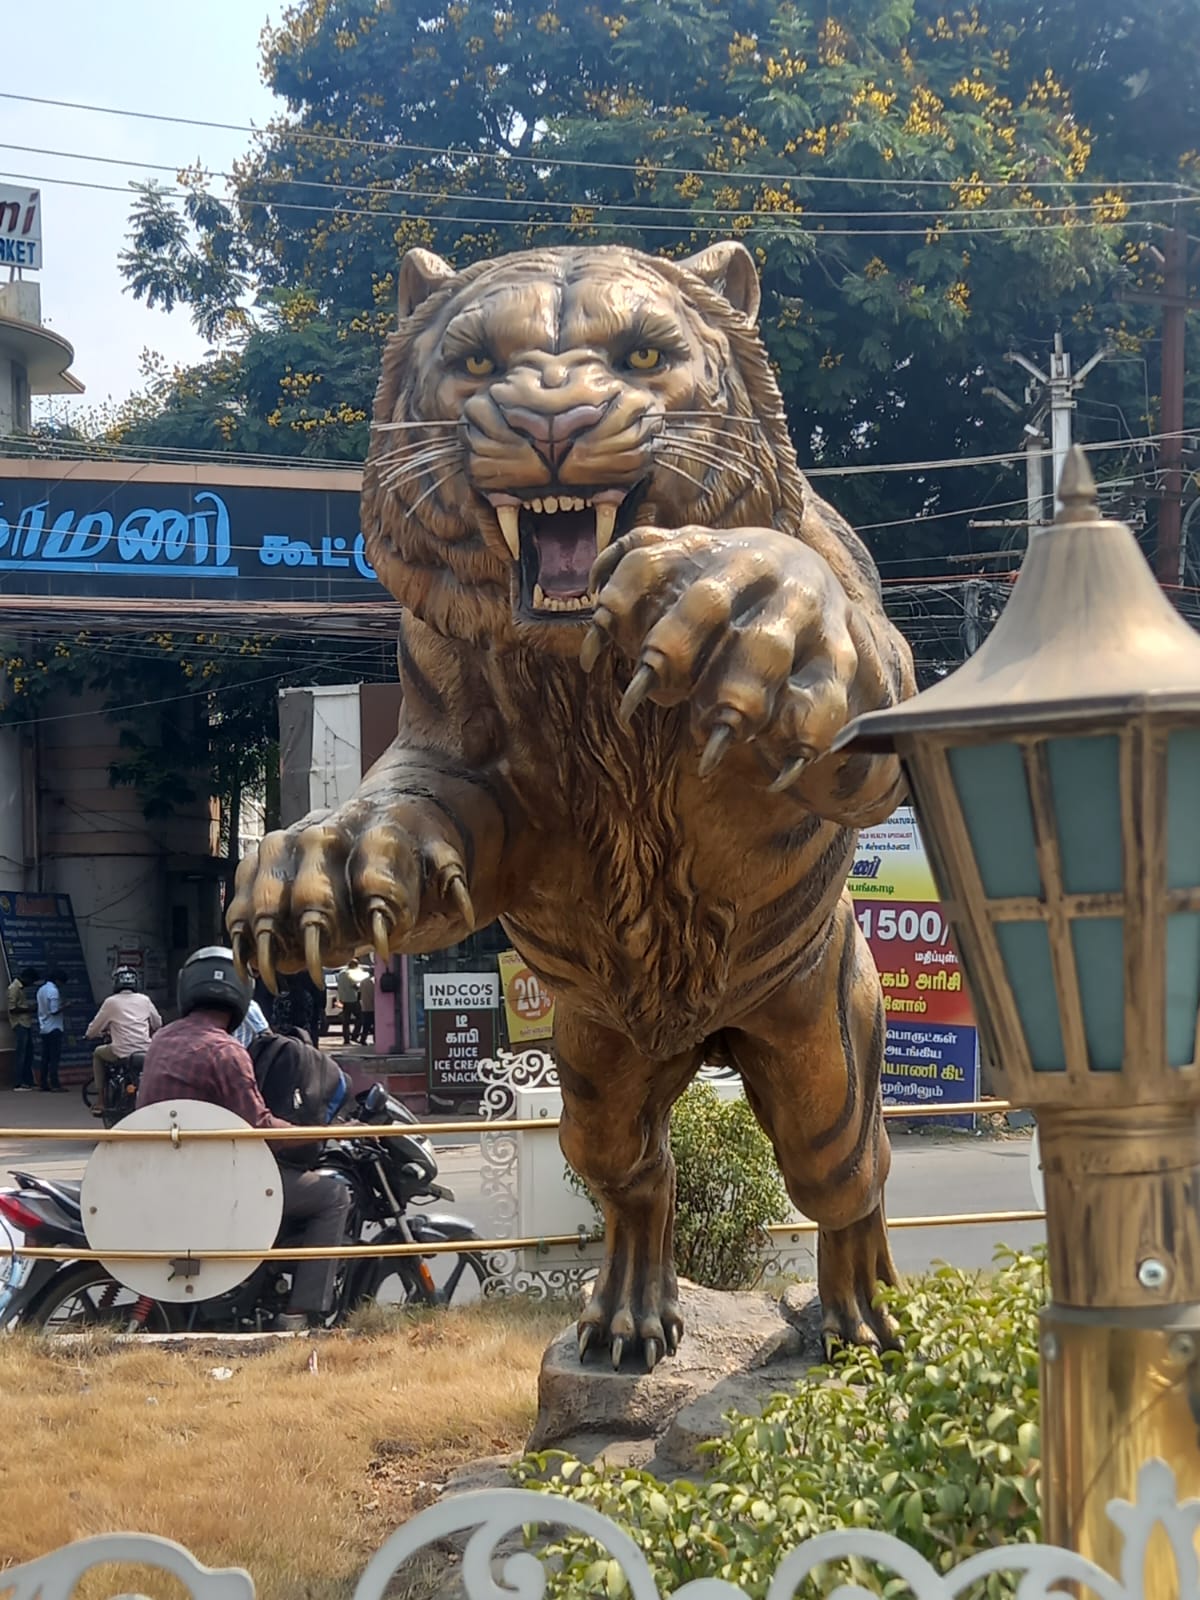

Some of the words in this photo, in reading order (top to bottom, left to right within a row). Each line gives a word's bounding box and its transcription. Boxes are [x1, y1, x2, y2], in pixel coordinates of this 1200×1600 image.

[915, 970, 961, 991] அரிசி
[430, 983, 493, 996] INDCO'S
[432, 998, 451, 1007] TEA
[455, 997, 491, 1006] HOUSE
[445, 1028, 479, 1043] காபி
[448, 1047, 479, 1058] JUICE
[434, 1060, 451, 1070] ICE
[941, 1064, 966, 1082] கிட்
